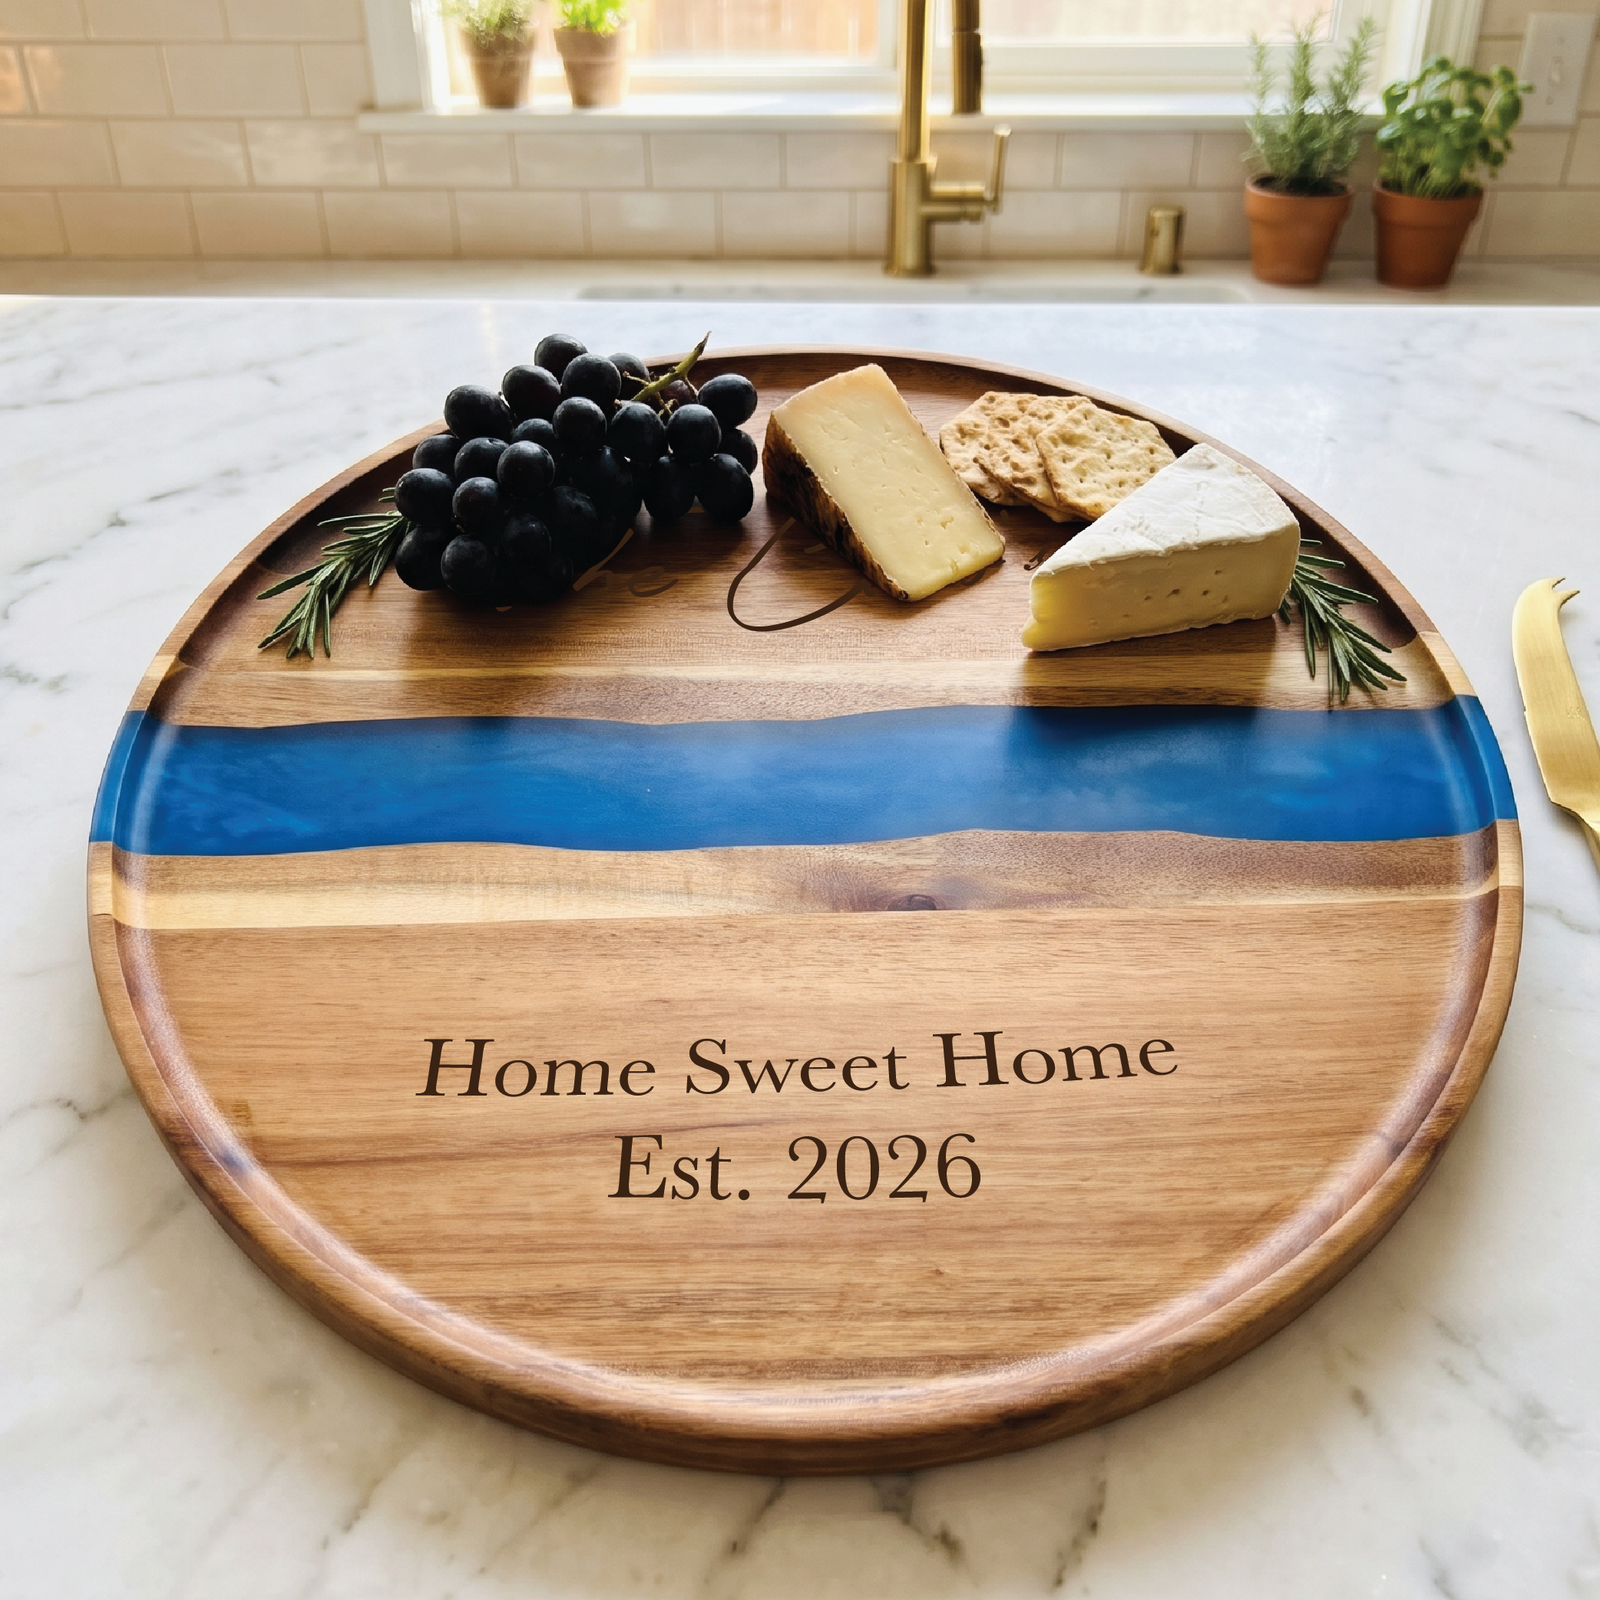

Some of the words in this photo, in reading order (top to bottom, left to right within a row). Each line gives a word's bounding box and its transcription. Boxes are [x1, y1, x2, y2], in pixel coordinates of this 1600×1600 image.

[415, 1037, 656, 1099] Home
[685, 1037, 911, 1096] Sweet
[932, 1030, 1179, 1088] Home
[607, 1133, 750, 1202] Est.
[787, 1132, 982, 1204] 2026
